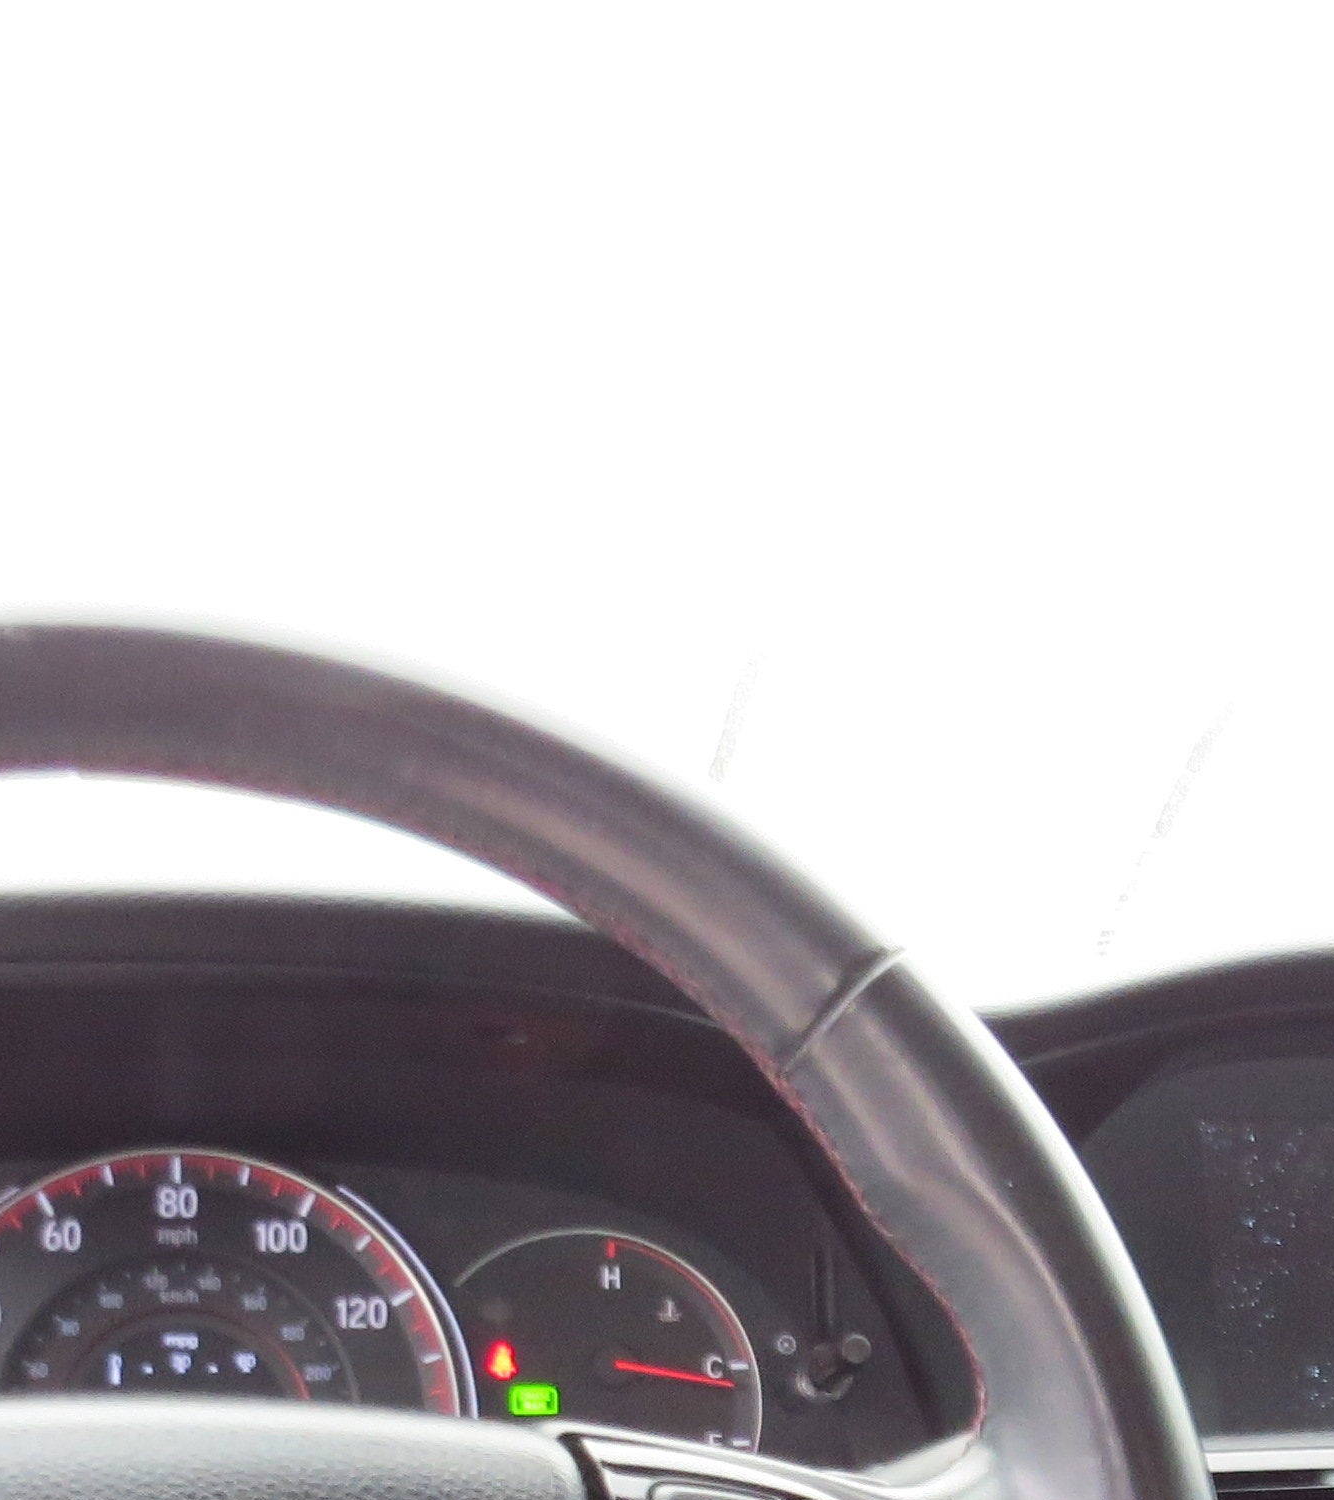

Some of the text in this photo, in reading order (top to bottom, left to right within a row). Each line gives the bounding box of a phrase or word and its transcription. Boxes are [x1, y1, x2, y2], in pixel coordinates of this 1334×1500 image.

[153, 1183, 198, 1219] 80
[40, 1219, 83, 1255] 60
[255, 1219, 309, 1255] 100
[598, 1262, 622, 1292] H
[335, 1295, 389, 1331] 120
[700, 1354, 725, 1380] C
